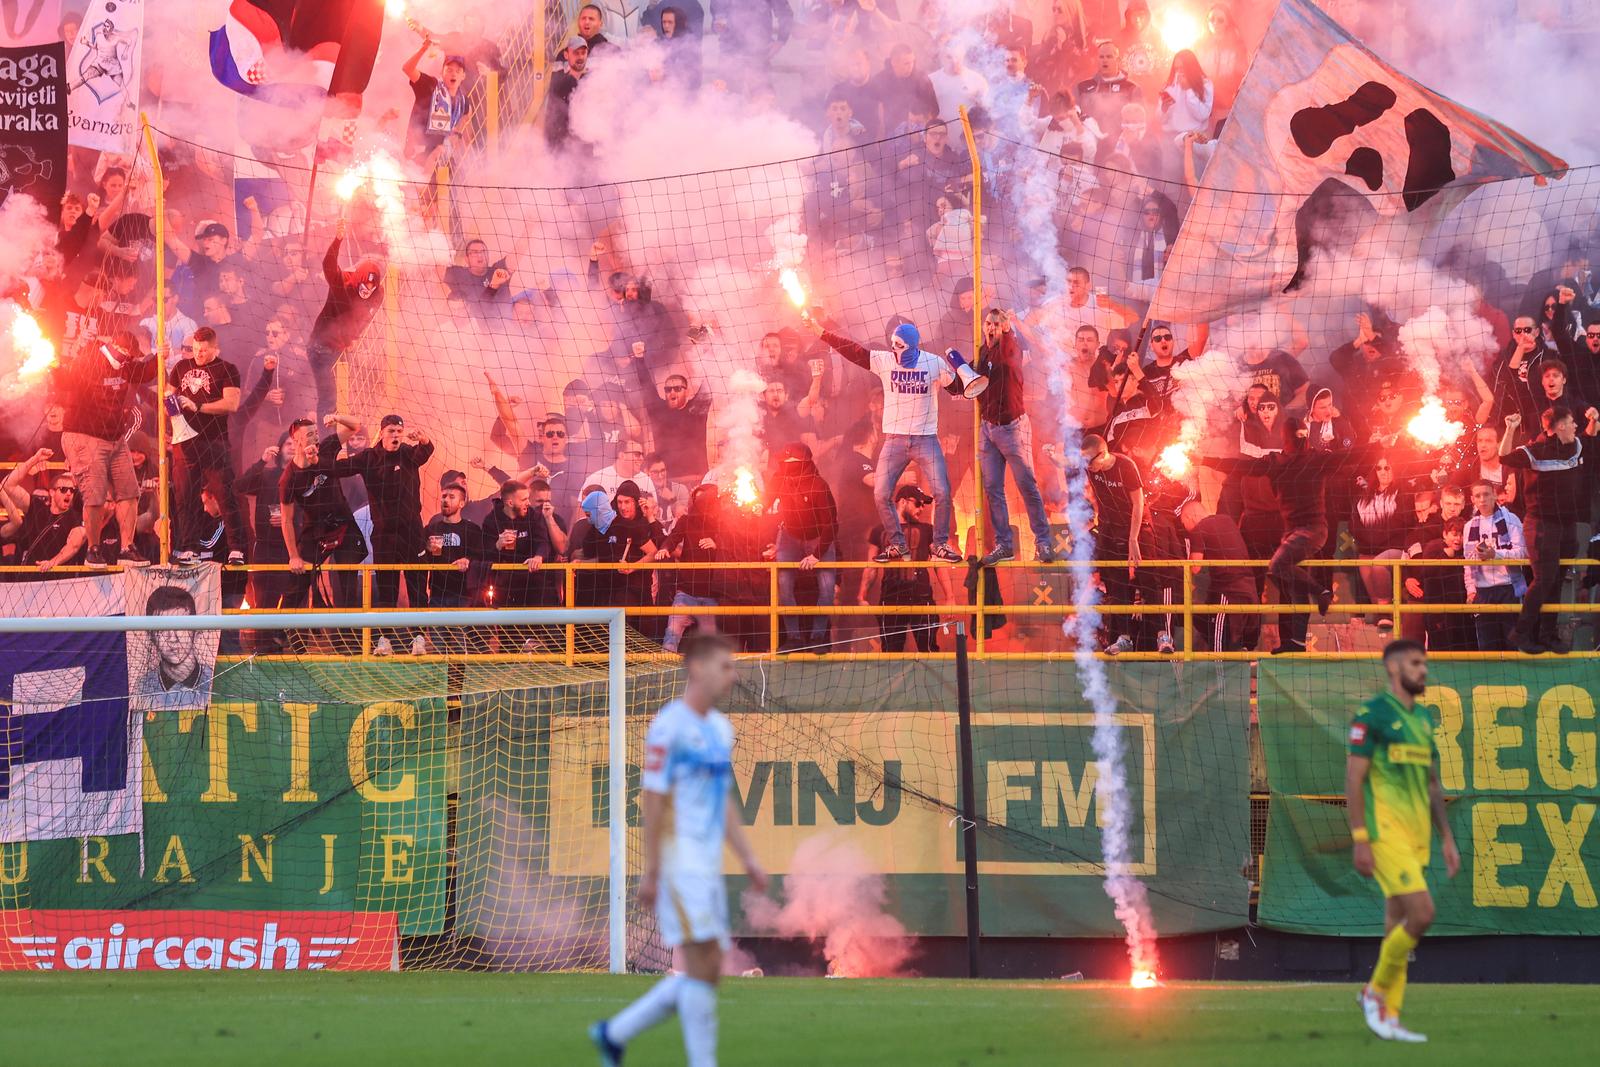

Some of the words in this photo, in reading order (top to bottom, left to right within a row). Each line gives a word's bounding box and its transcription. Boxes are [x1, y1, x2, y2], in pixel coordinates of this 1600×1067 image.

[0, 53, 58, 87] aga
[1414, 684, 1597, 791] REG
[592, 761, 902, 828] RVINJ
[986, 761, 1112, 828] FM
[1472, 802, 1599, 908] EX
[64, 923, 302, 970] aircash
